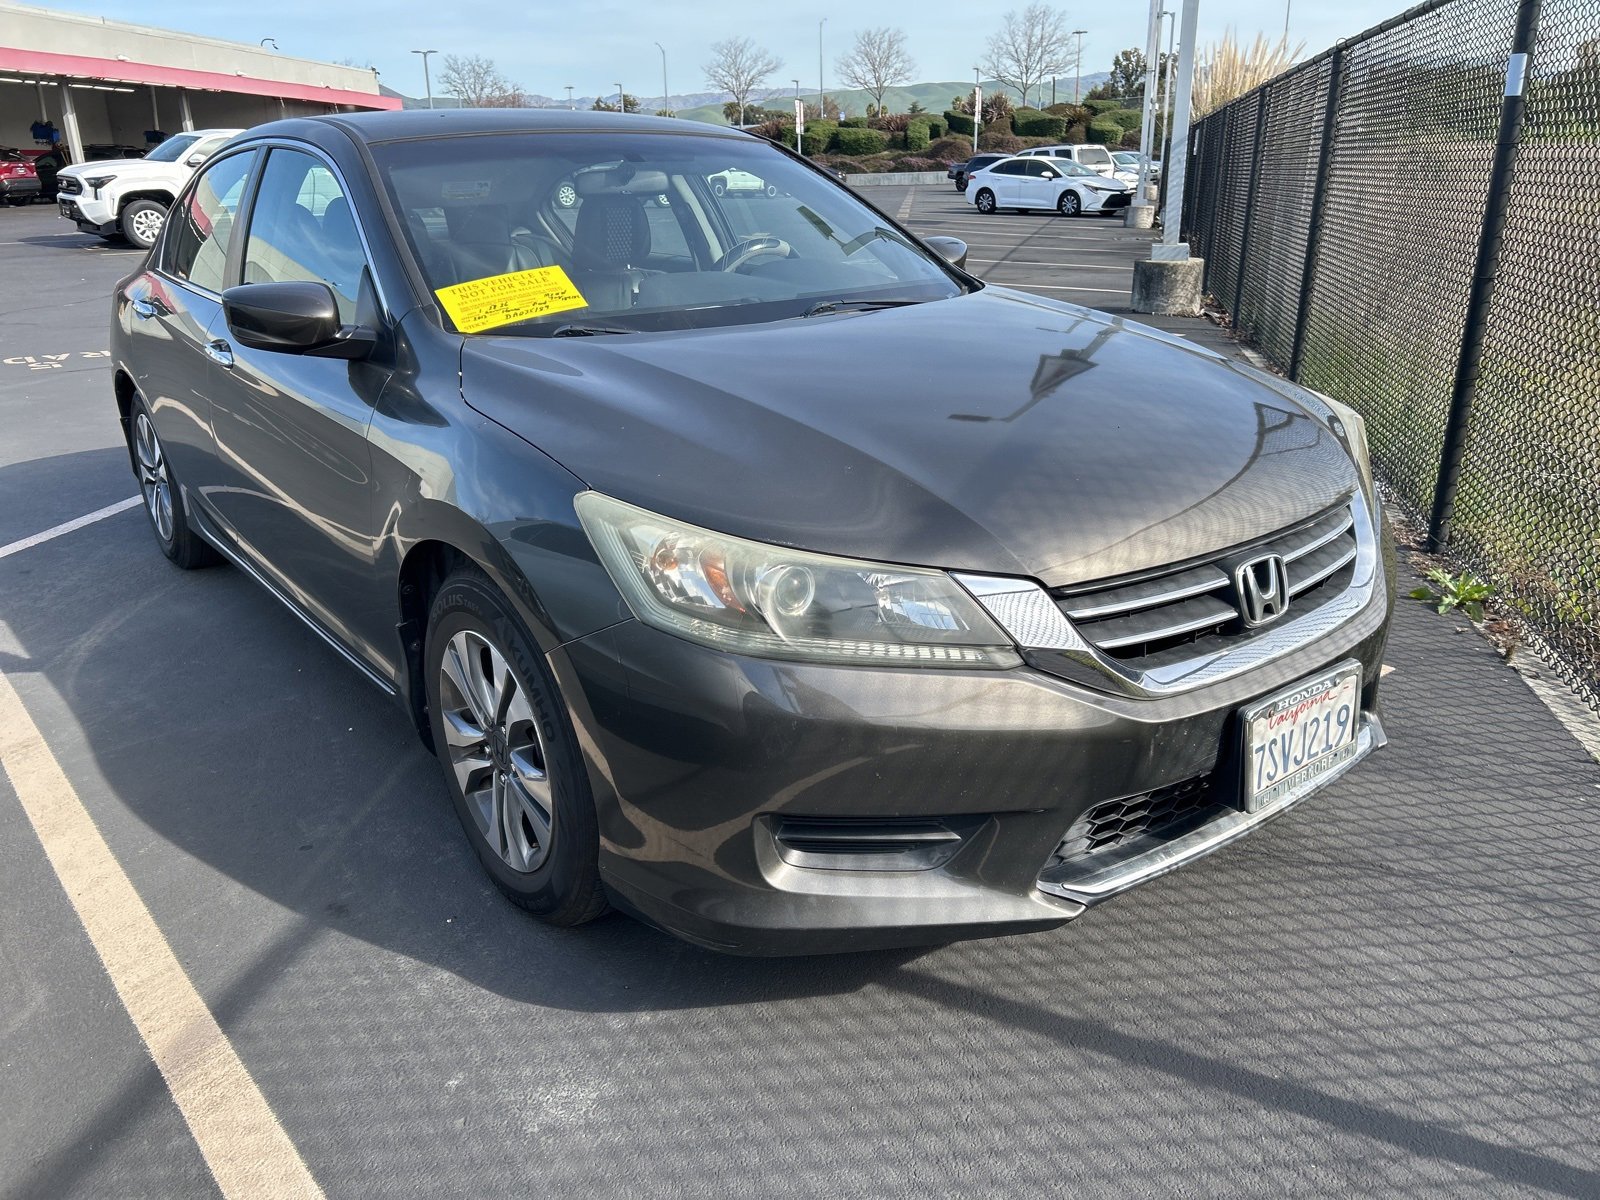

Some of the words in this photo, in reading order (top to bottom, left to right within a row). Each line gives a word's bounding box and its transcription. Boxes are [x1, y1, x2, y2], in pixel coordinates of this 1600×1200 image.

[449, 283, 479, 295] THIS
[482, 272, 535, 288] VEHICLE
[538, 269, 551, 277] IS
[460, 288, 485, 300] NOT
[490, 283, 515, 293] FOR
[518, 276, 549, 287] SALE
[432, 594, 464, 622] SOLUS
[509, 646, 555, 742] KUMHO
[1277, 679, 1333, 710] HONDA
[1267, 690, 1338, 731] California
[1254, 703, 1351, 790] 7SVJ219
